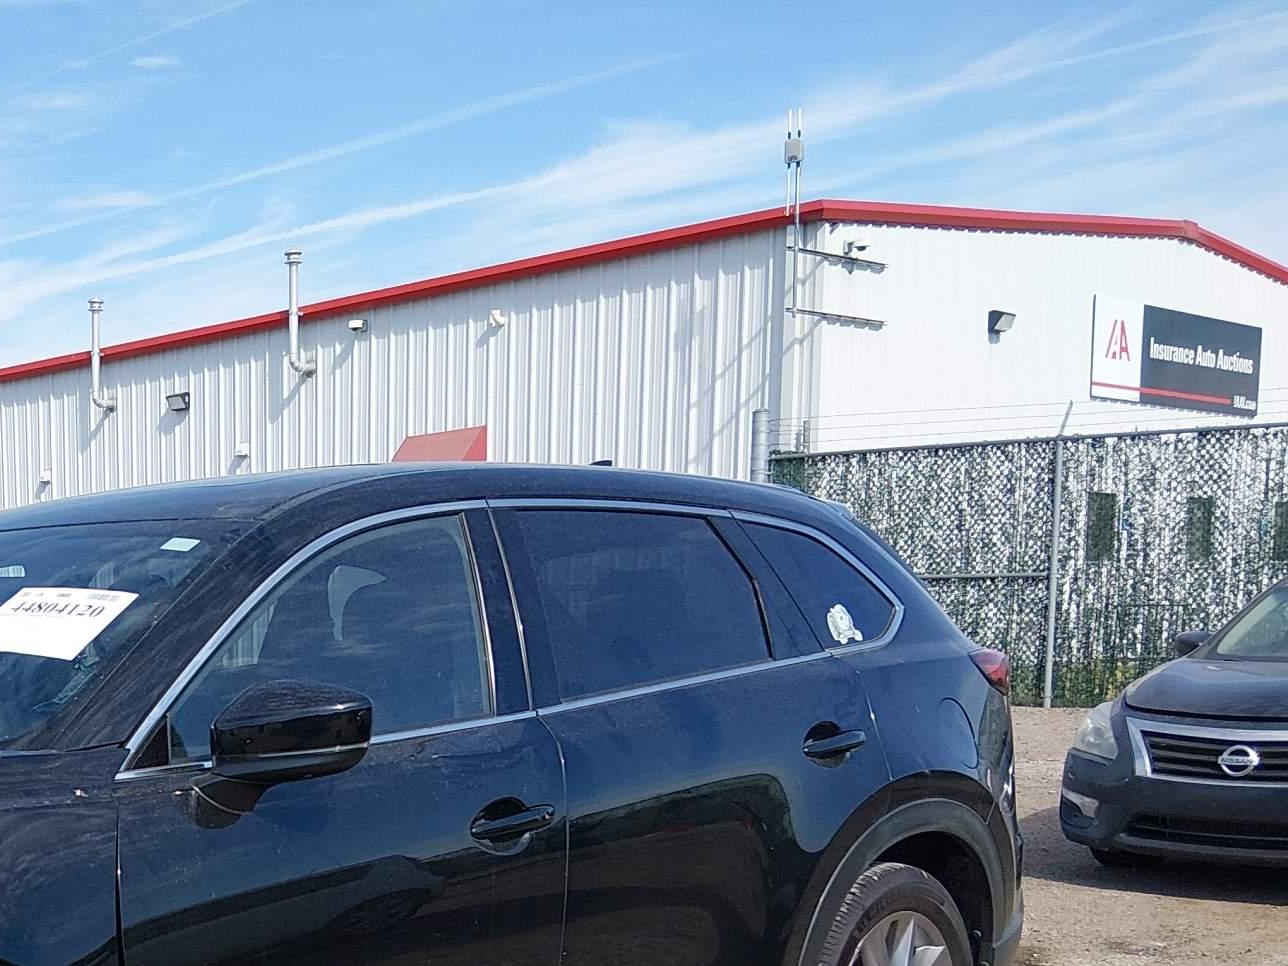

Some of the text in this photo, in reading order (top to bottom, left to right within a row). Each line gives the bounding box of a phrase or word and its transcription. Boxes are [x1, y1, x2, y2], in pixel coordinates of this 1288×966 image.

[1150, 337, 1254, 374] Insurance Auto Auctions
[11, 601, 105, 617] 44804120
